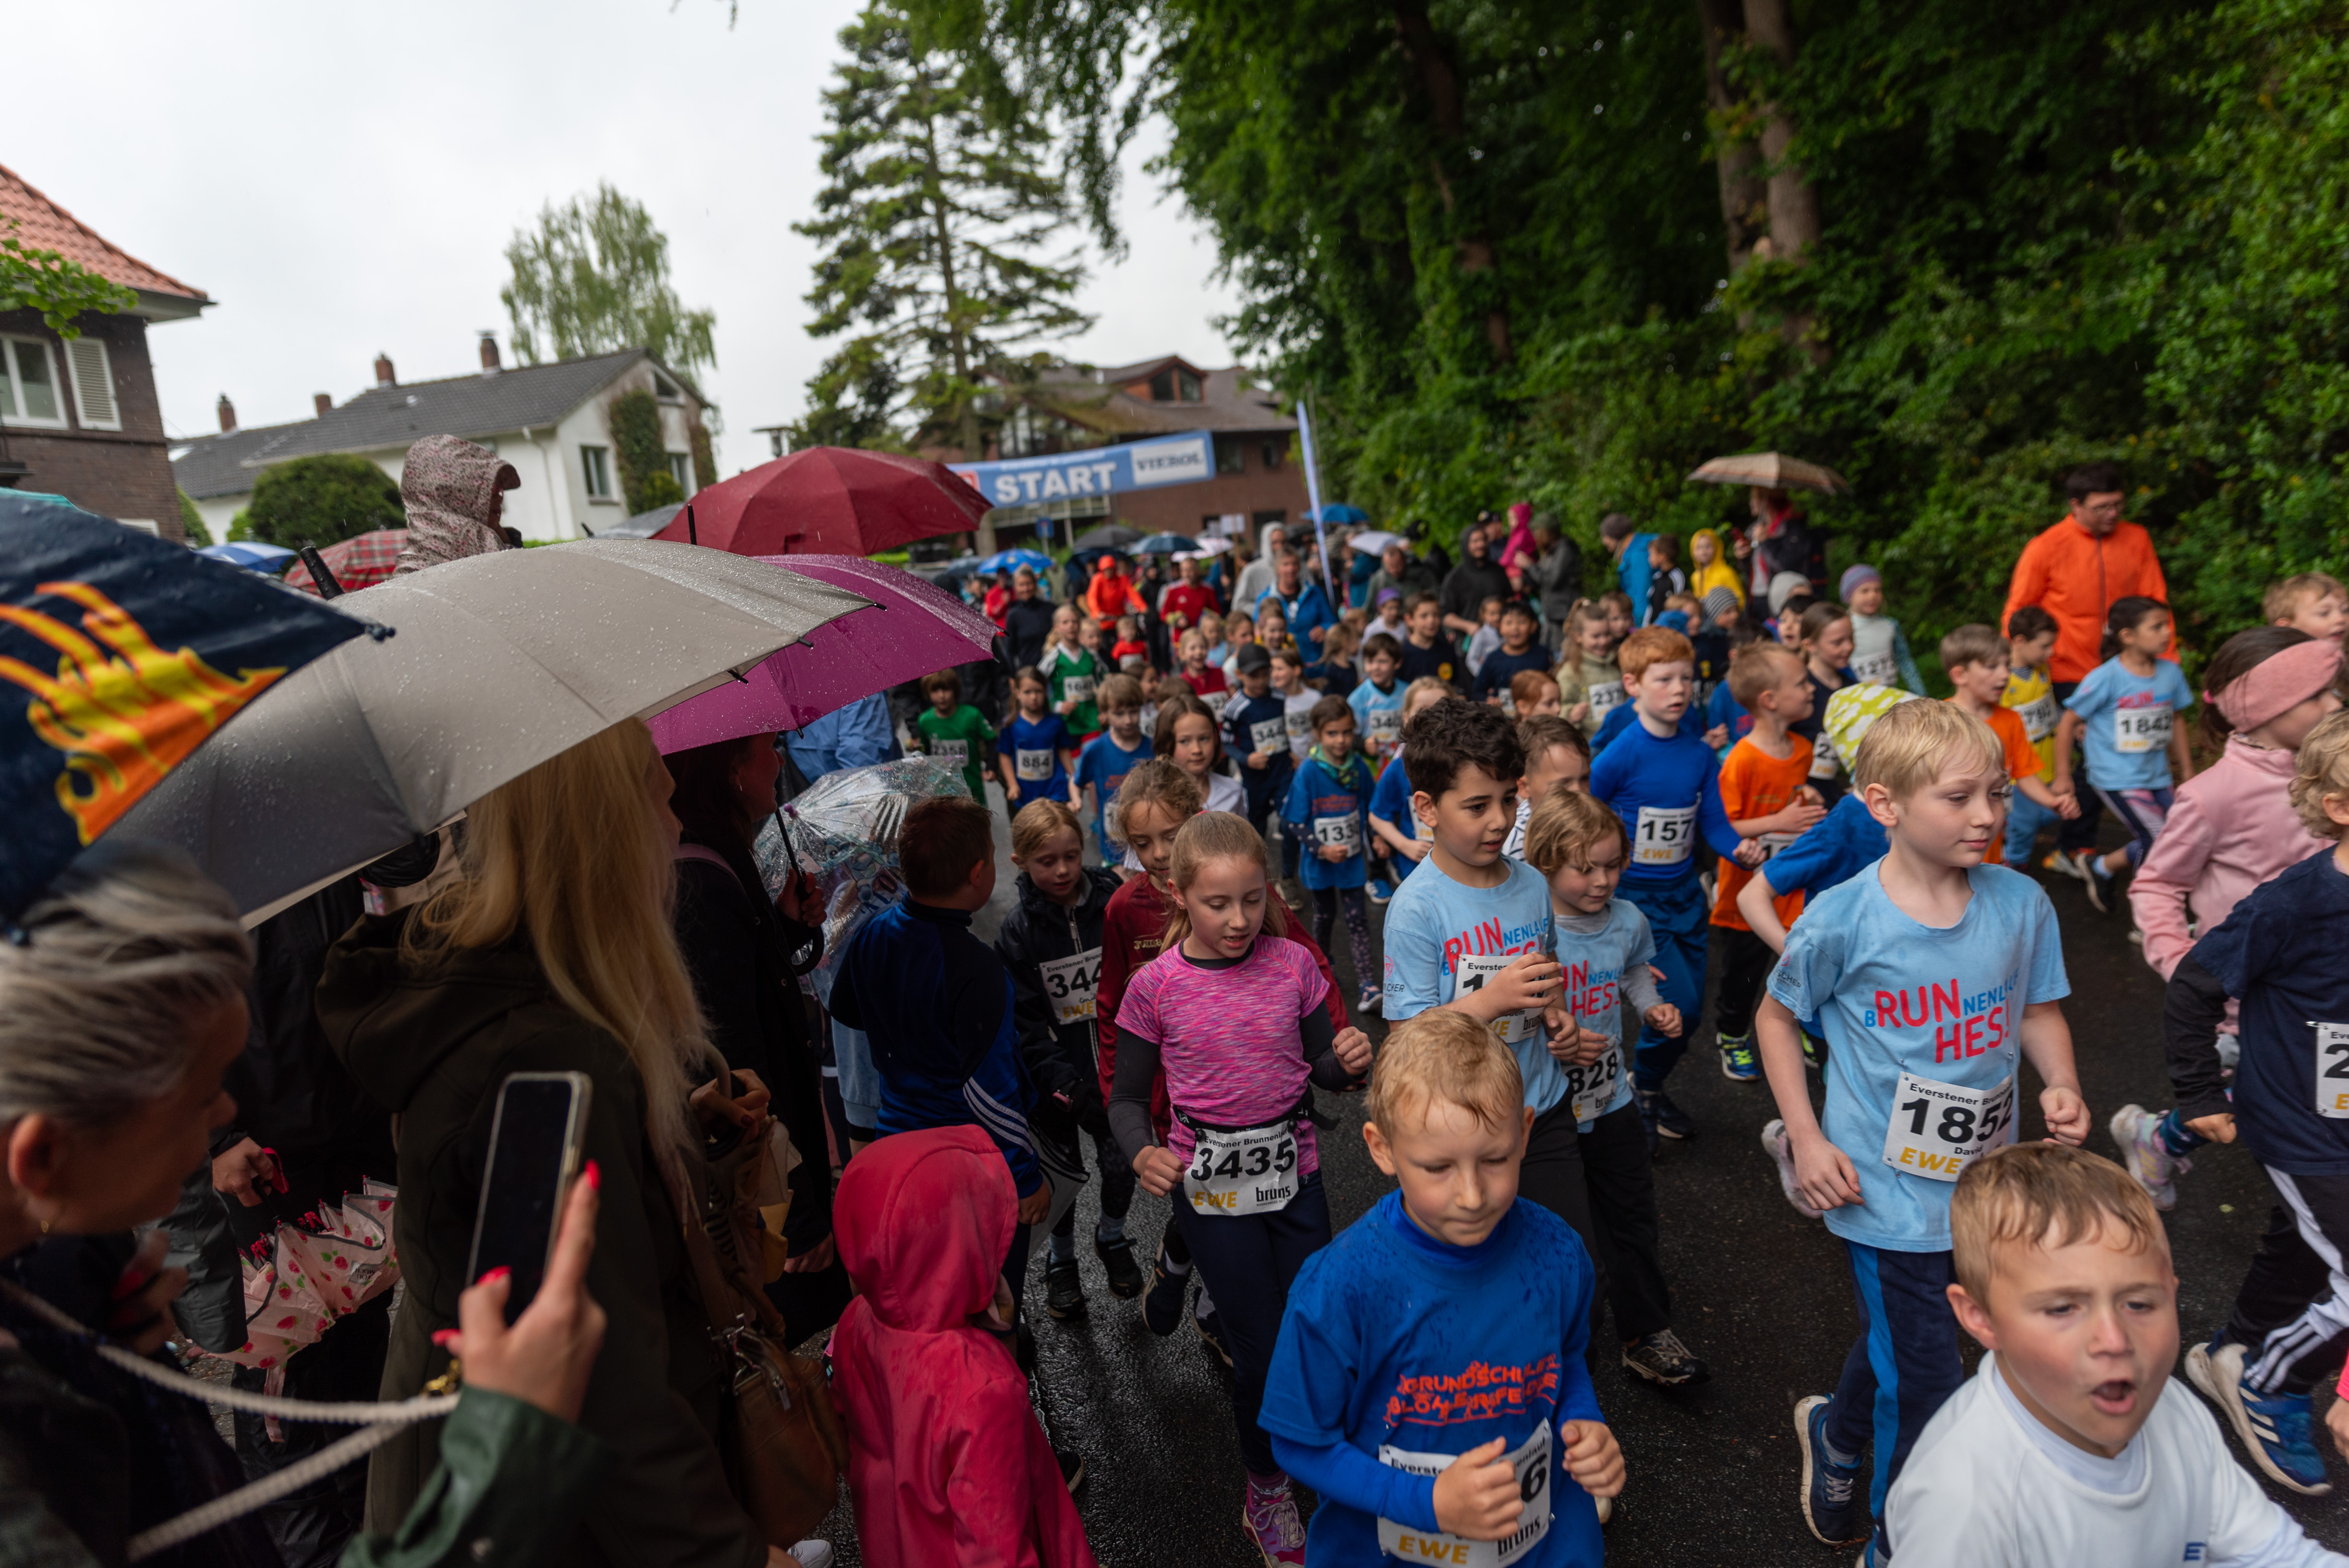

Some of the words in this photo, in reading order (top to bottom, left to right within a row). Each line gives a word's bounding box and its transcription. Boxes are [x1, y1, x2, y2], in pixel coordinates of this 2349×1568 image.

[995, 461, 1117, 505] START
[1022, 756, 1050, 768] 884
[1642, 819, 1694, 841] 157
[1642, 848, 1672, 859] EWE
[1047, 959, 1084, 972] Everstener
[1063, 1001, 1094, 1018] EWE
[1935, 1006, 2009, 1063] HES!
[1910, 1083, 1979, 1106] Everstener
[1191, 1137, 1295, 1181] 3435
[1899, 1146, 1963, 1174] EWE
[1193, 1191, 1238, 1208] EWE
[1255, 1185, 1291, 1202] bruns
[1398, 1535, 1470, 1565] EWE
